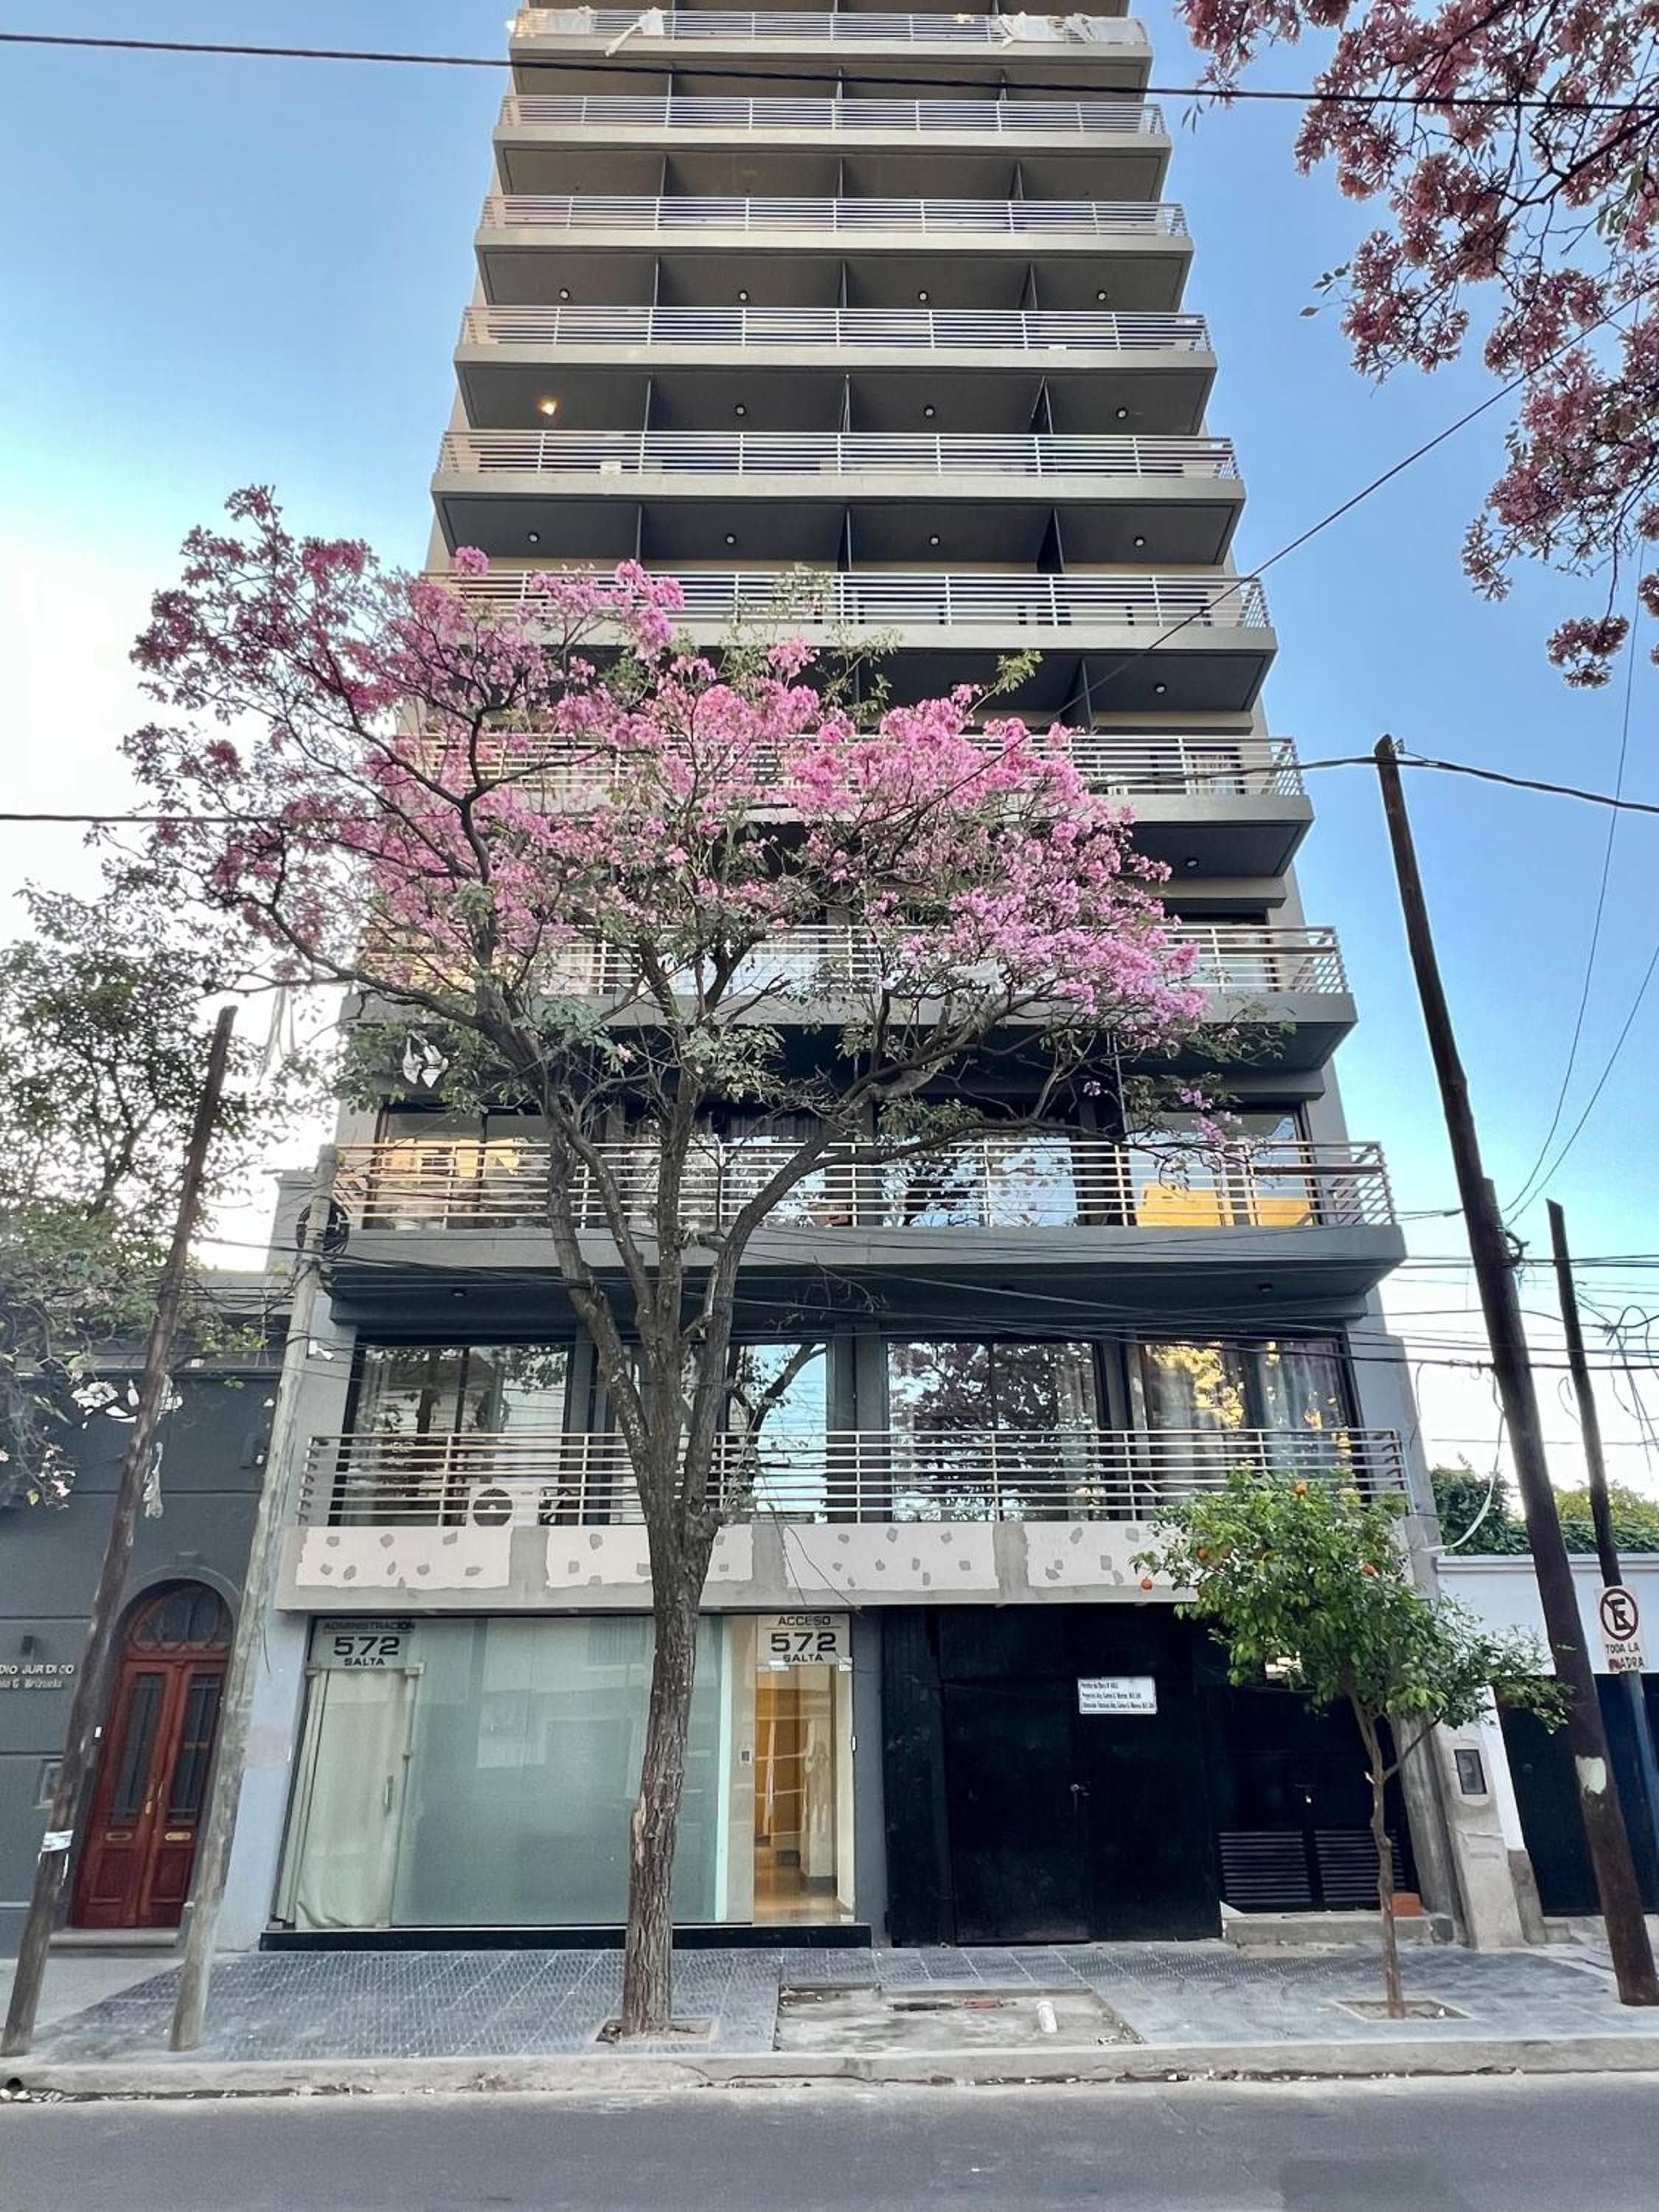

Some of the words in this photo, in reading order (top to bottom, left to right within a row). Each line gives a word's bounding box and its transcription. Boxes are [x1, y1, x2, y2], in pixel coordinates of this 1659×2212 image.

[778, 1615, 831, 1625] ACCESO
[333, 1636, 400, 1655] 572
[771, 1632, 836, 1652] 572
[1606, 1644, 1626, 1654] TODA
[1628, 1642, 1640, 1652] LA
[344, 1658, 385, 1666] SALTA
[783, 1654, 824, 1662] SALTA
[1609, 1657, 1645, 1671] ADRA
